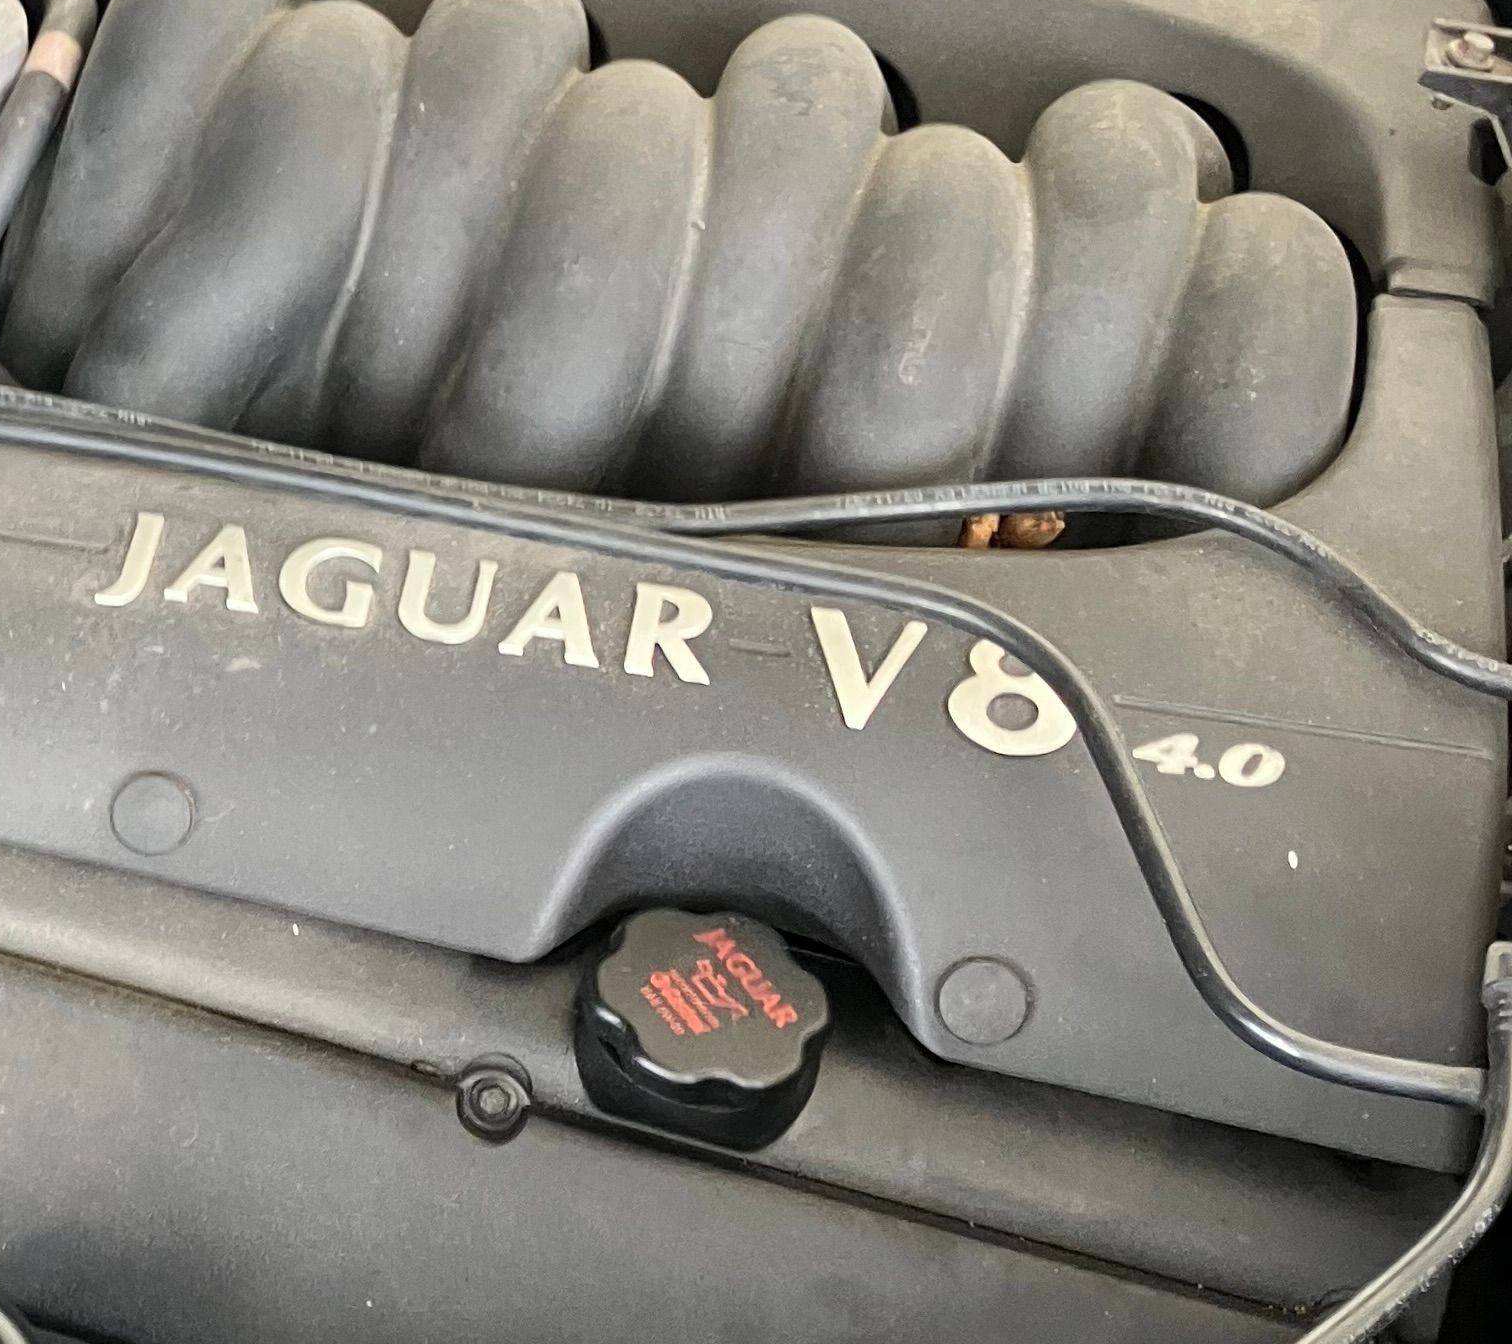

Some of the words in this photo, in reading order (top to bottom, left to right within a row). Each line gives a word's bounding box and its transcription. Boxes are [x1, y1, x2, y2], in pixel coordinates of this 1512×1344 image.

[94, 512, 710, 685] JAGUAR
[1132, 733, 1285, 787] 4.0
[693, 928, 798, 1028] JAGUAR
